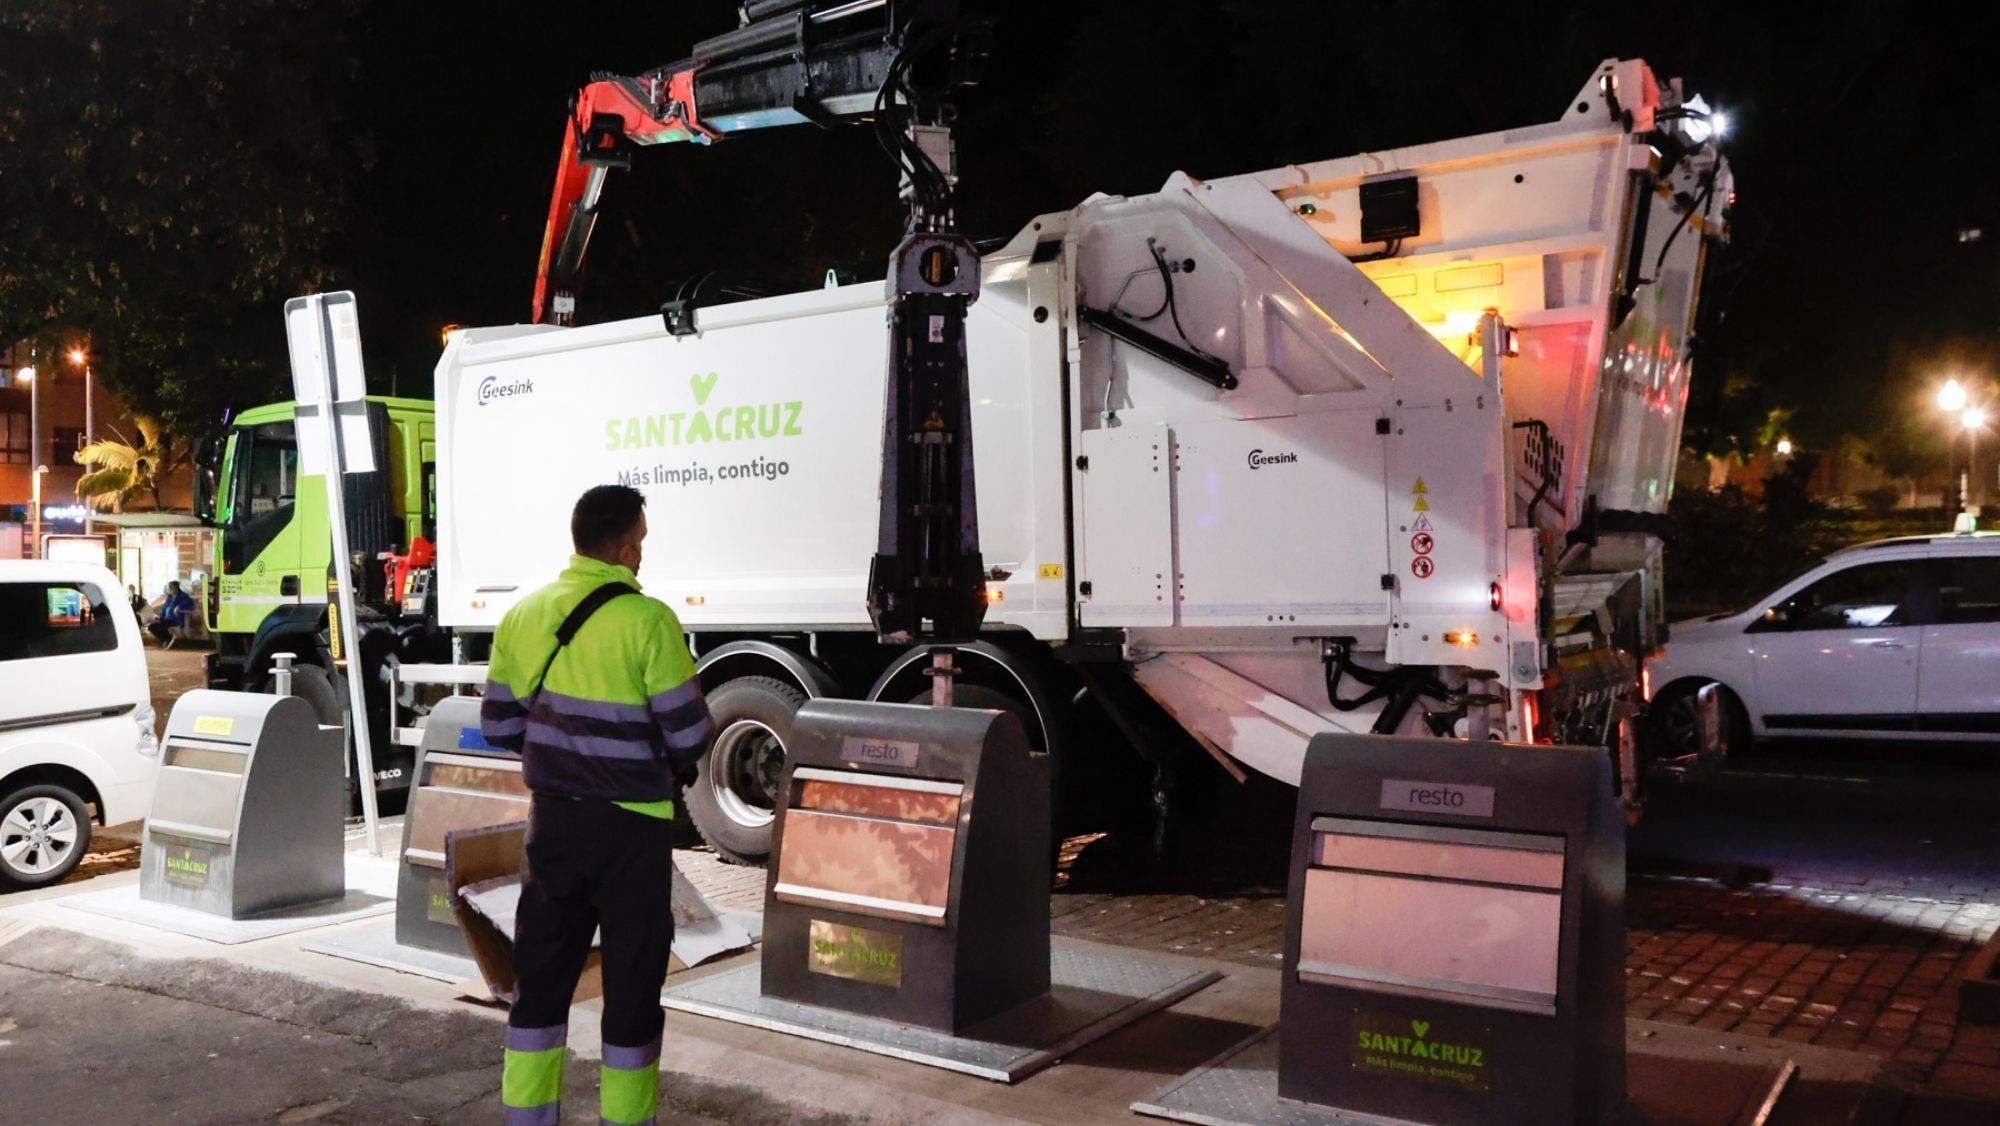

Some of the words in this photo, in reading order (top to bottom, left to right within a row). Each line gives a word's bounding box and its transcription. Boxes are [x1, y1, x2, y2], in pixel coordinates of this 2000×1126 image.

[478, 376, 534, 405] Geesink
[1248, 449, 1298, 469] Geesink
[618, 467, 650, 487] Más
[654, 462, 714, 486] limpia,
[718, 456, 790, 481] contigo
[861, 743, 898, 759] resto
[373, 768, 402, 780] VECO
[1410, 787, 1464, 807] resto
